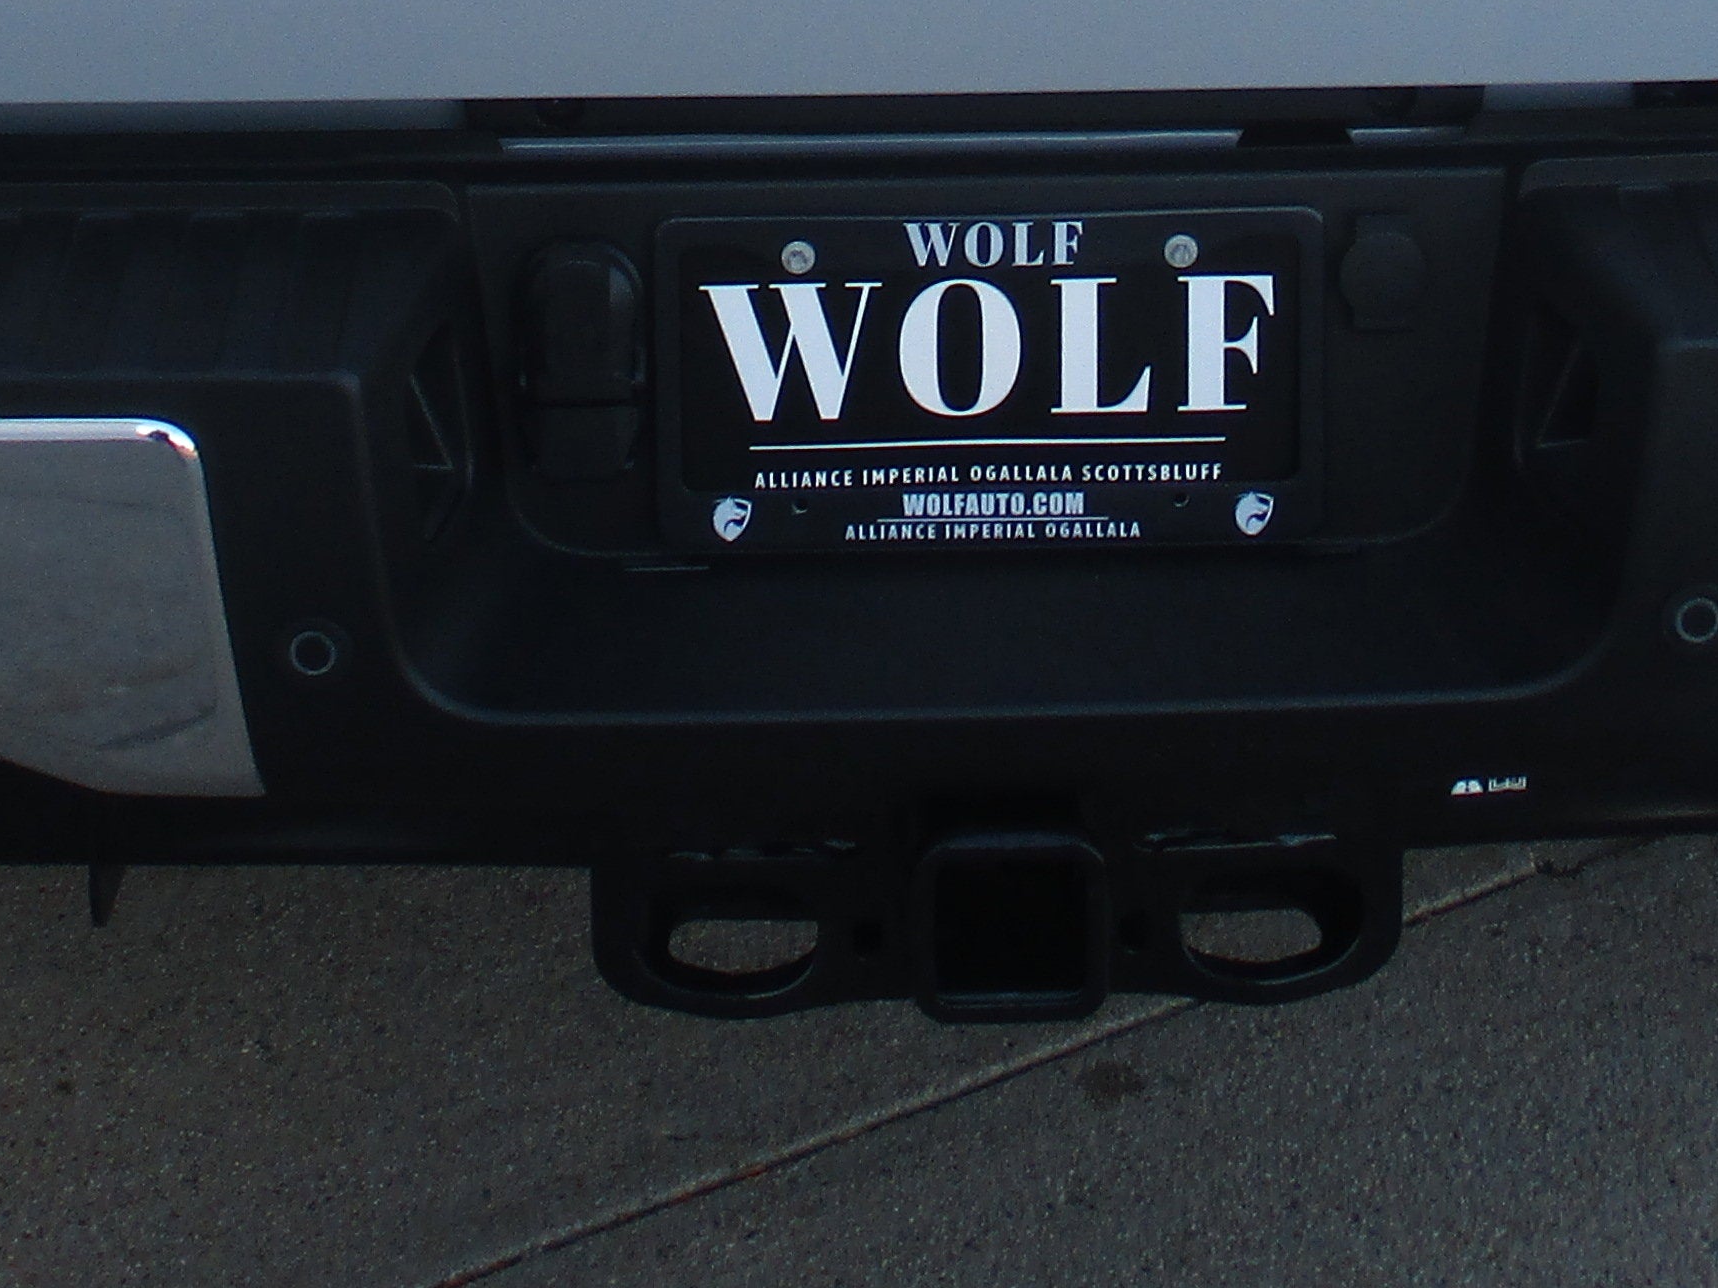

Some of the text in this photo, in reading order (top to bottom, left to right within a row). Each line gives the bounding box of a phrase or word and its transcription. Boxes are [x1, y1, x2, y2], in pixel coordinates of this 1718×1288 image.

[903, 220, 1083, 268] WOLF
[698, 274, 1275, 422] WOLF
[754, 462, 1223, 489] ALLIANCE IMPERIAL OGALLALA SCOTTSBLUFF
[902, 492, 1085, 517] WOLFAUTO.COM
[844, 521, 1142, 541] ALLIANCE IMPERIAL OGALLALA
